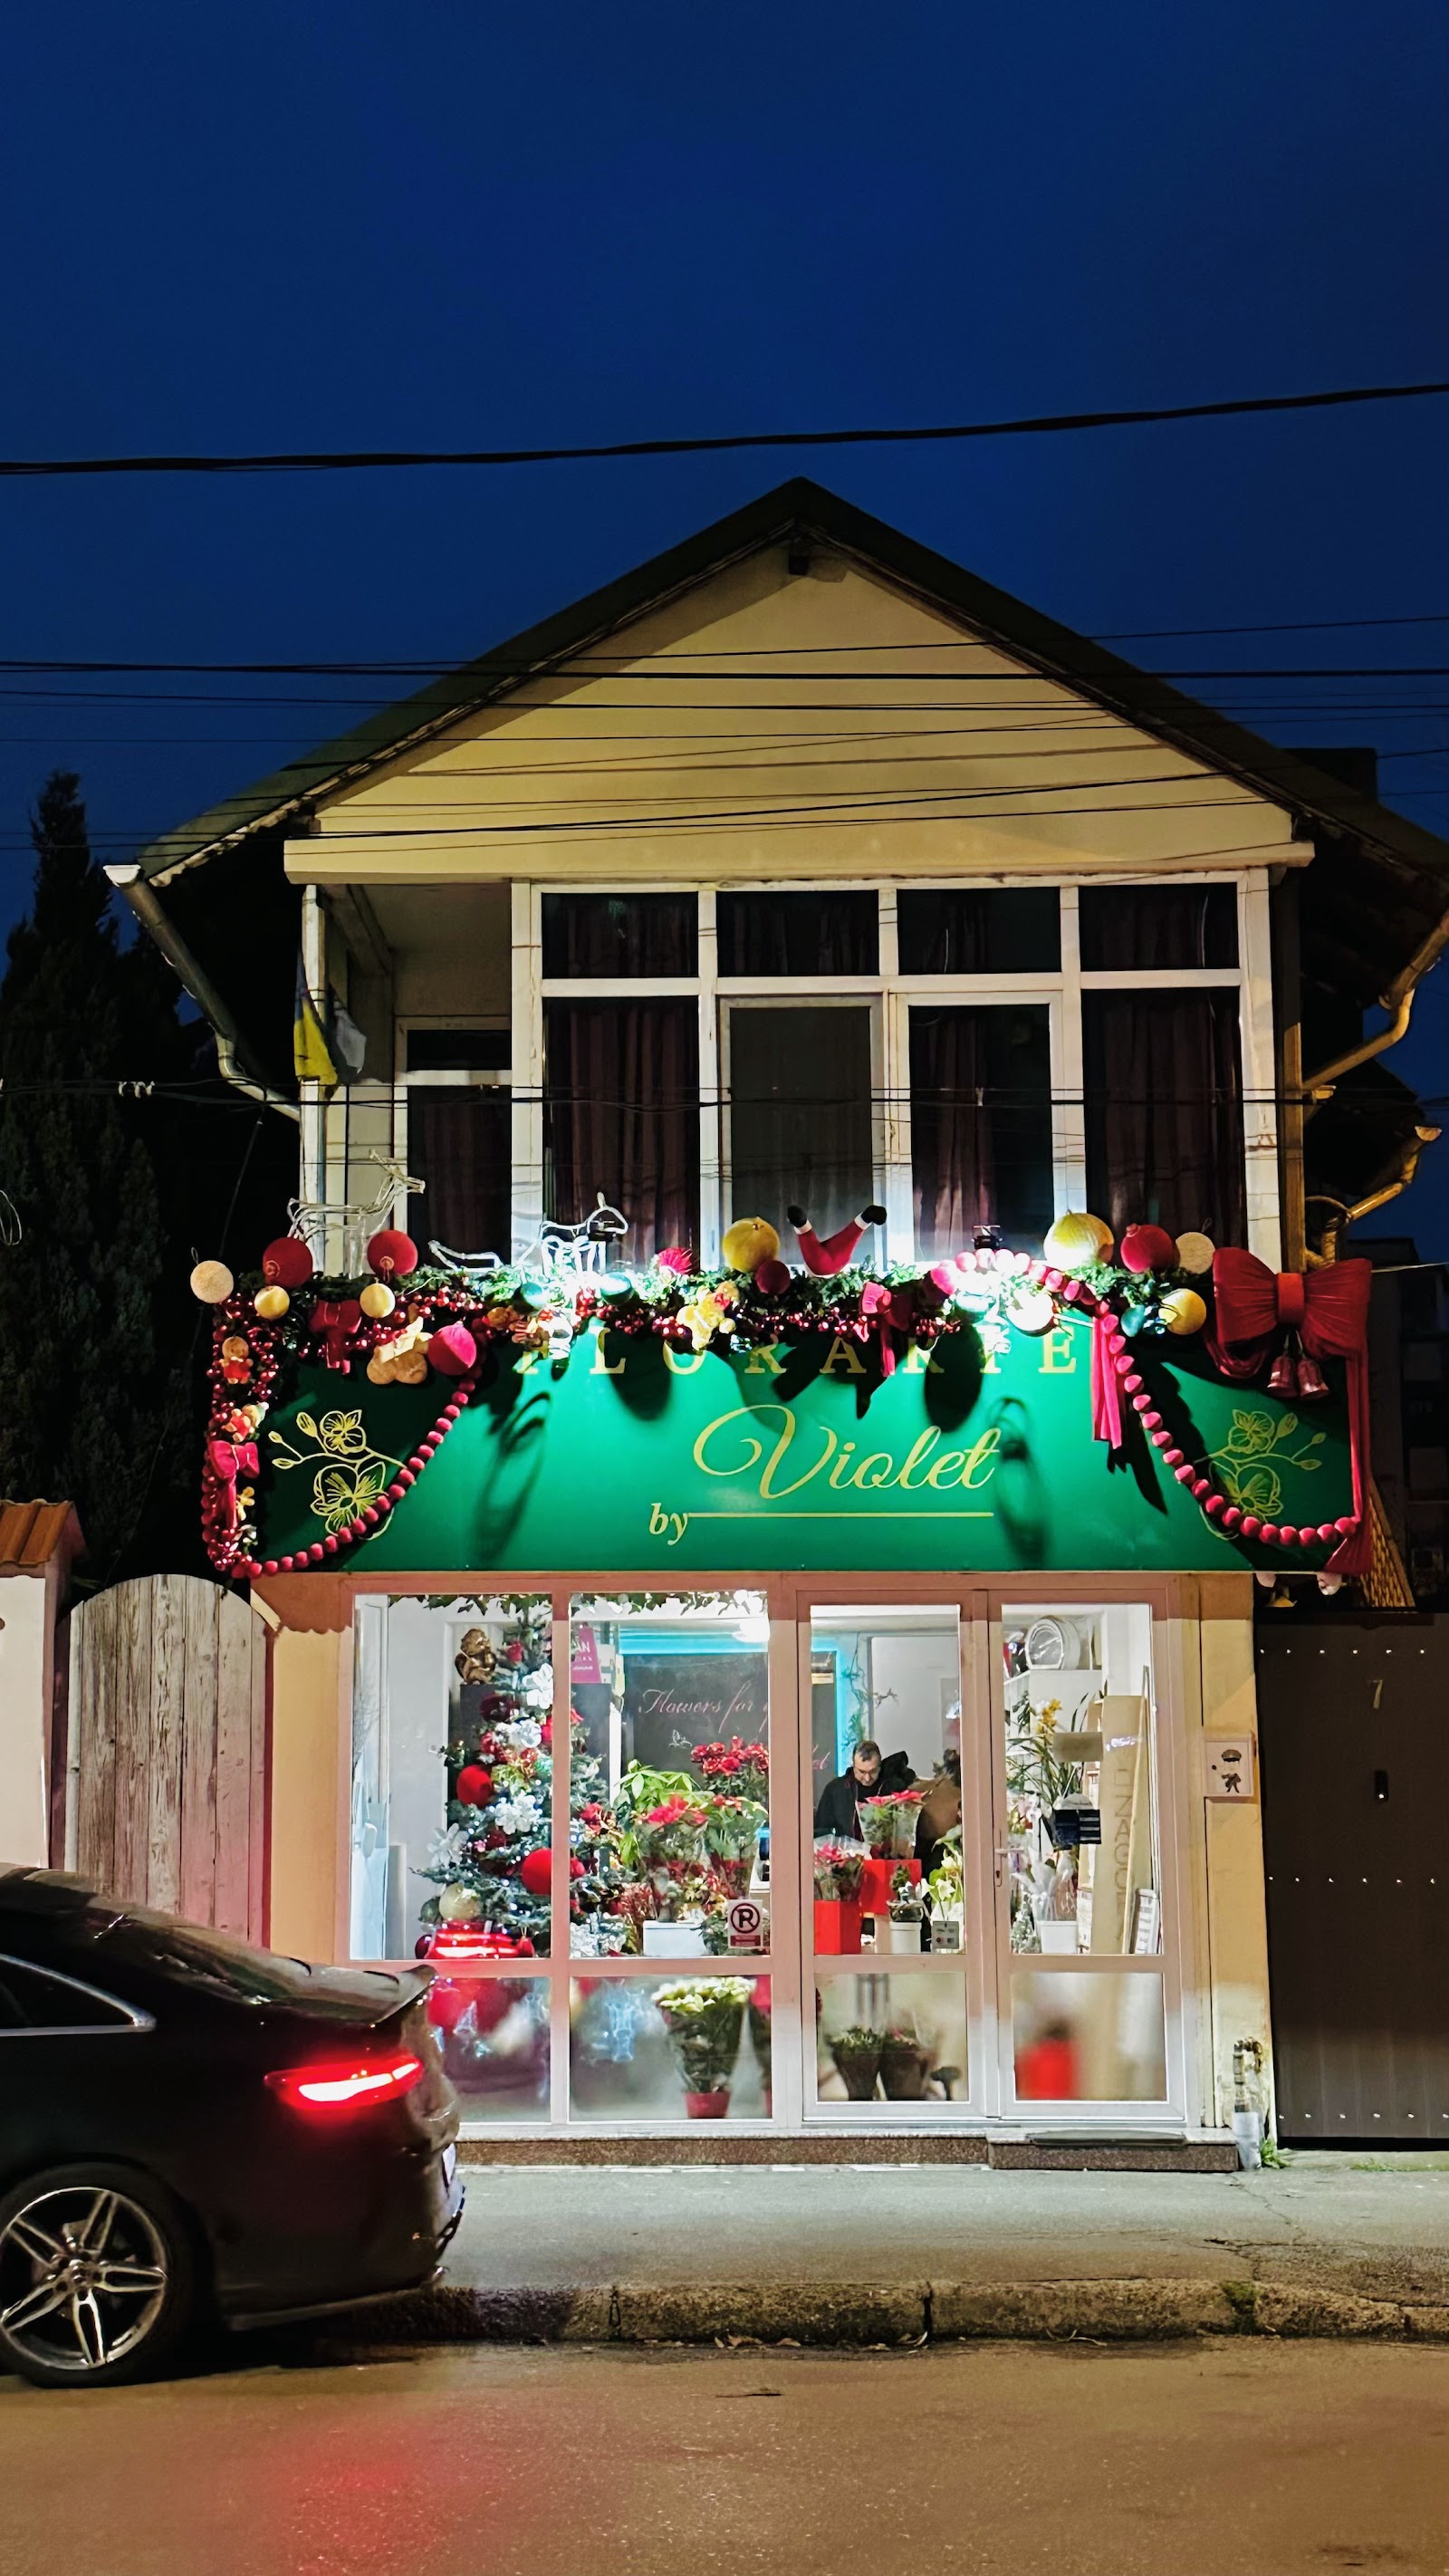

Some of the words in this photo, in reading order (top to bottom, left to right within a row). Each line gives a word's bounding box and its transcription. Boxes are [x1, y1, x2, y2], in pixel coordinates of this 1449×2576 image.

[693, 1404, 1002, 1500] Violet
[648, 1502, 688, 1546] by
[638, 1687, 723, 1714] Flowers
[718, 1679, 753, 1735] for
